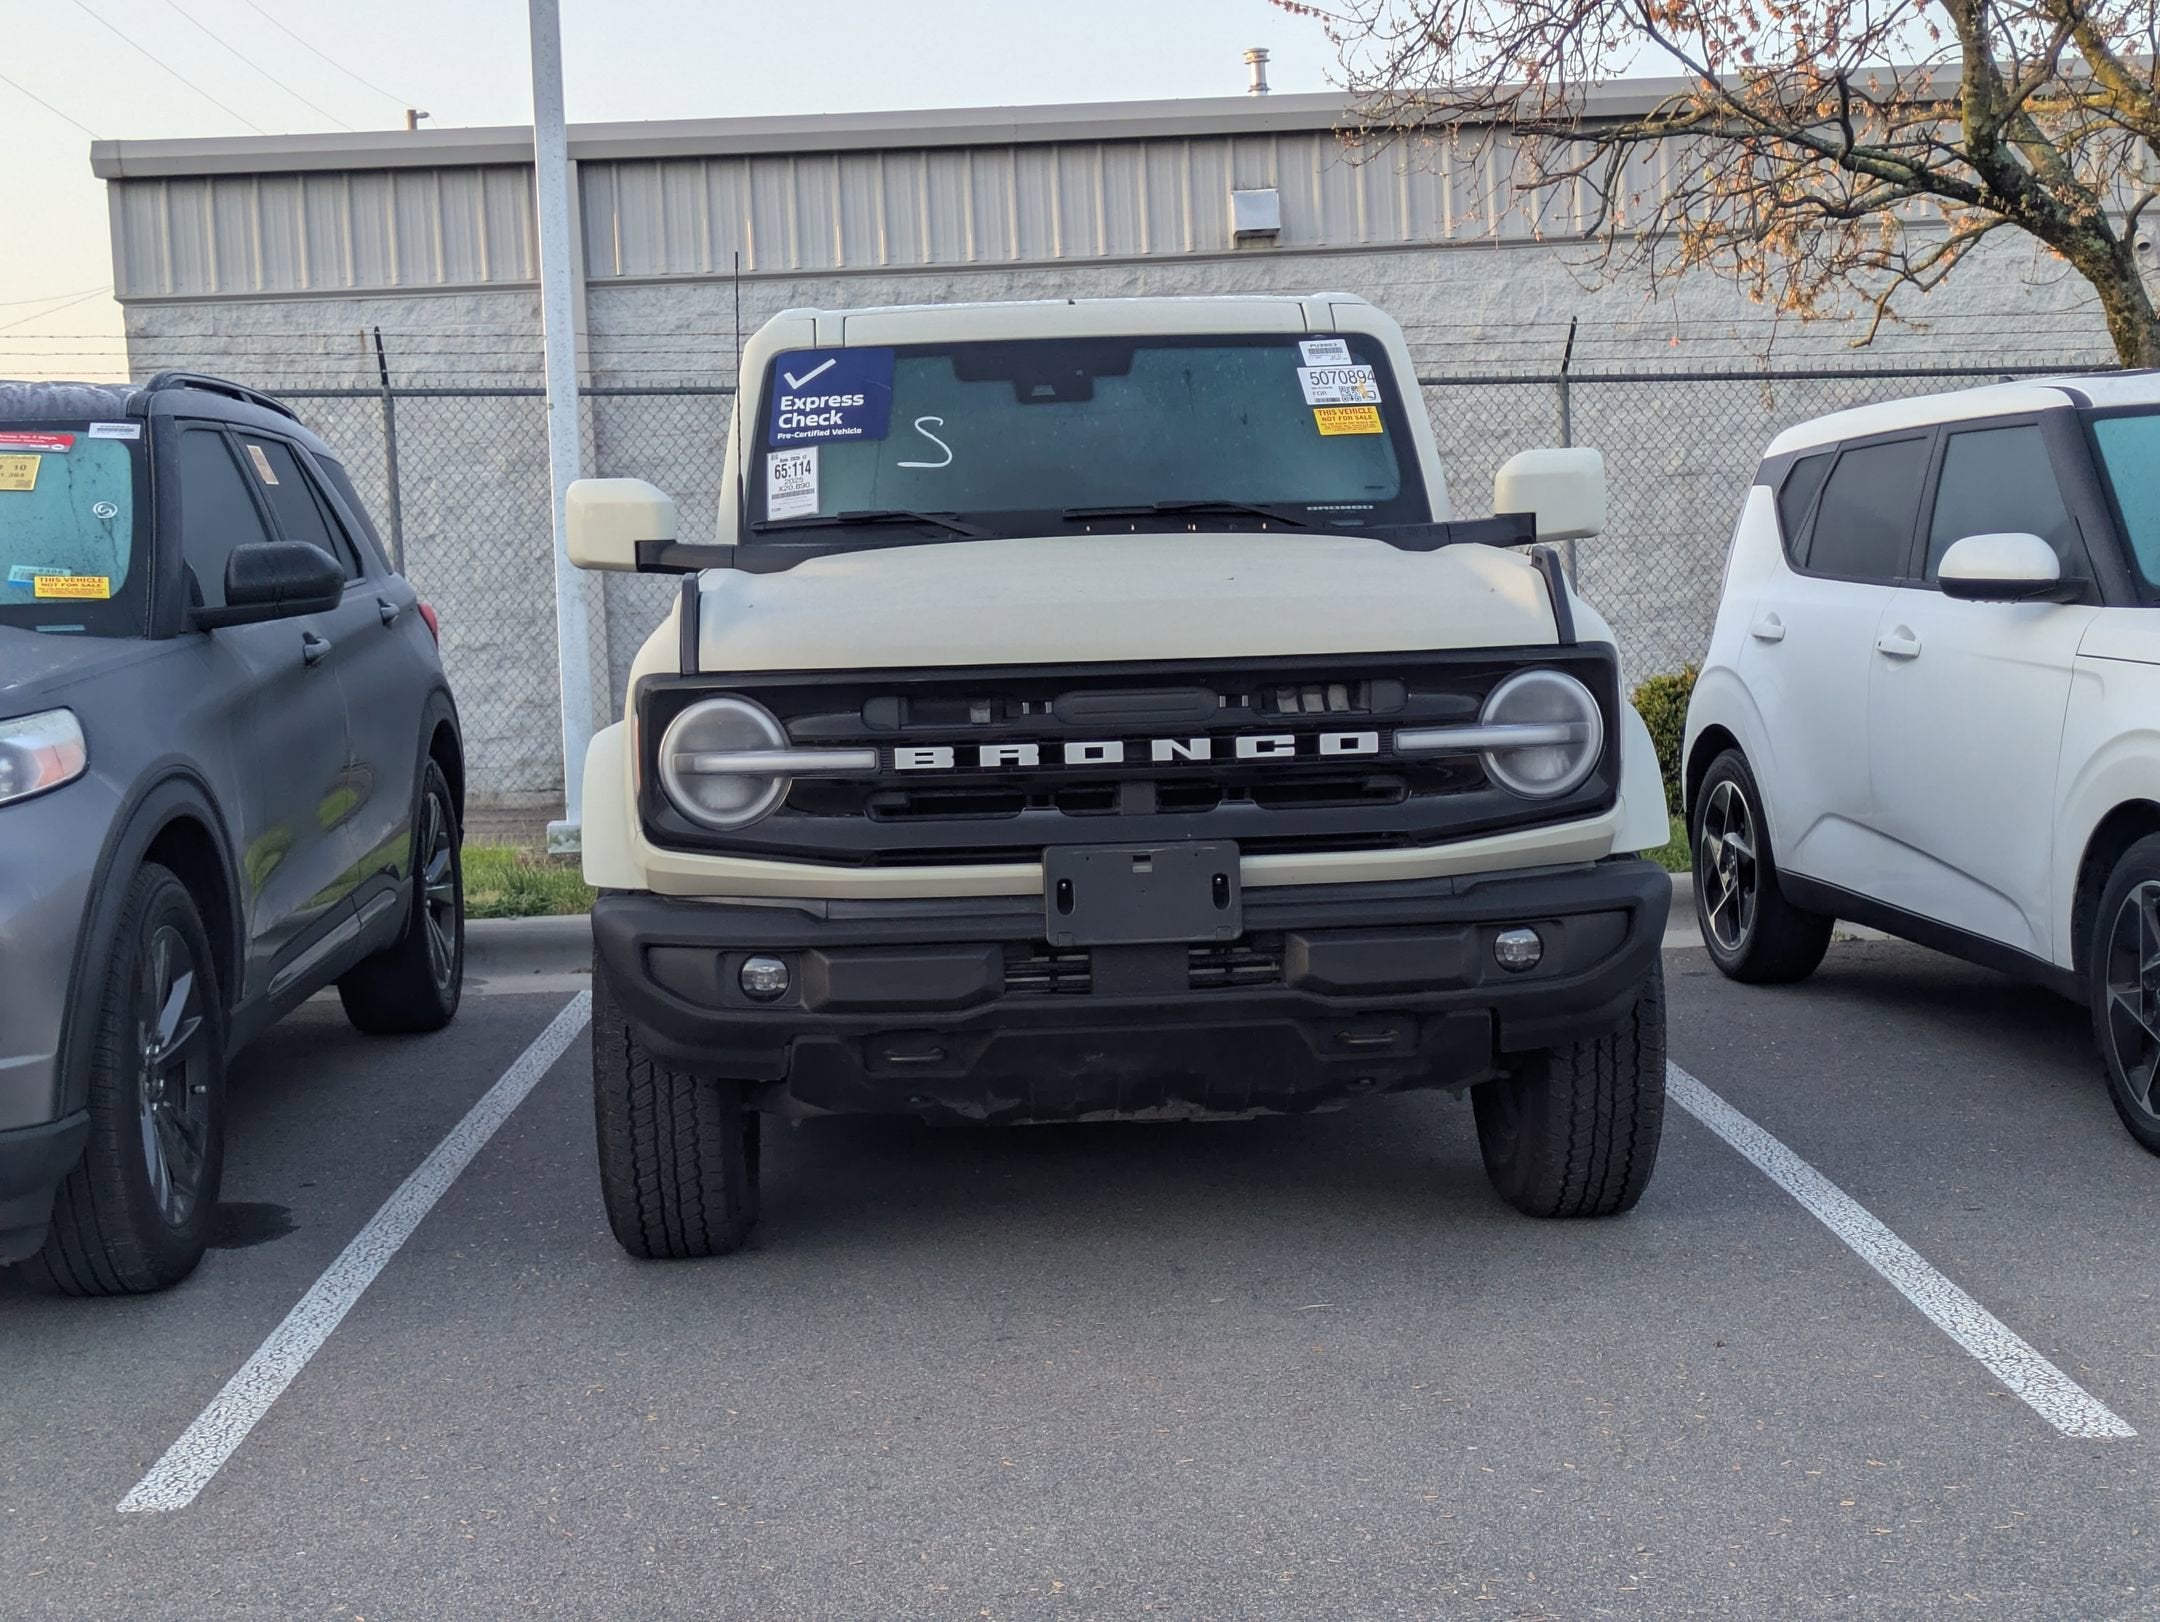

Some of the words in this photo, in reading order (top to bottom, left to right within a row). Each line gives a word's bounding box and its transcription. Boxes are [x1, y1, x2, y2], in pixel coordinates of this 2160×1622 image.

[1309, 369, 1376, 386] 5070894
[780, 394, 865, 412] Express
[1317, 409, 1337, 417] THIS
[1339, 407, 1374, 415] VEHICLE
[778, 409, 843, 429] Check
[777, 428, 830, 440] Pre-Certified
[832, 426, 862, 436] Vehicle
[896, 415, 953, 469] S
[774, 459, 812, 480] 65:114
[894, 731, 1379, 769] BRONCO
